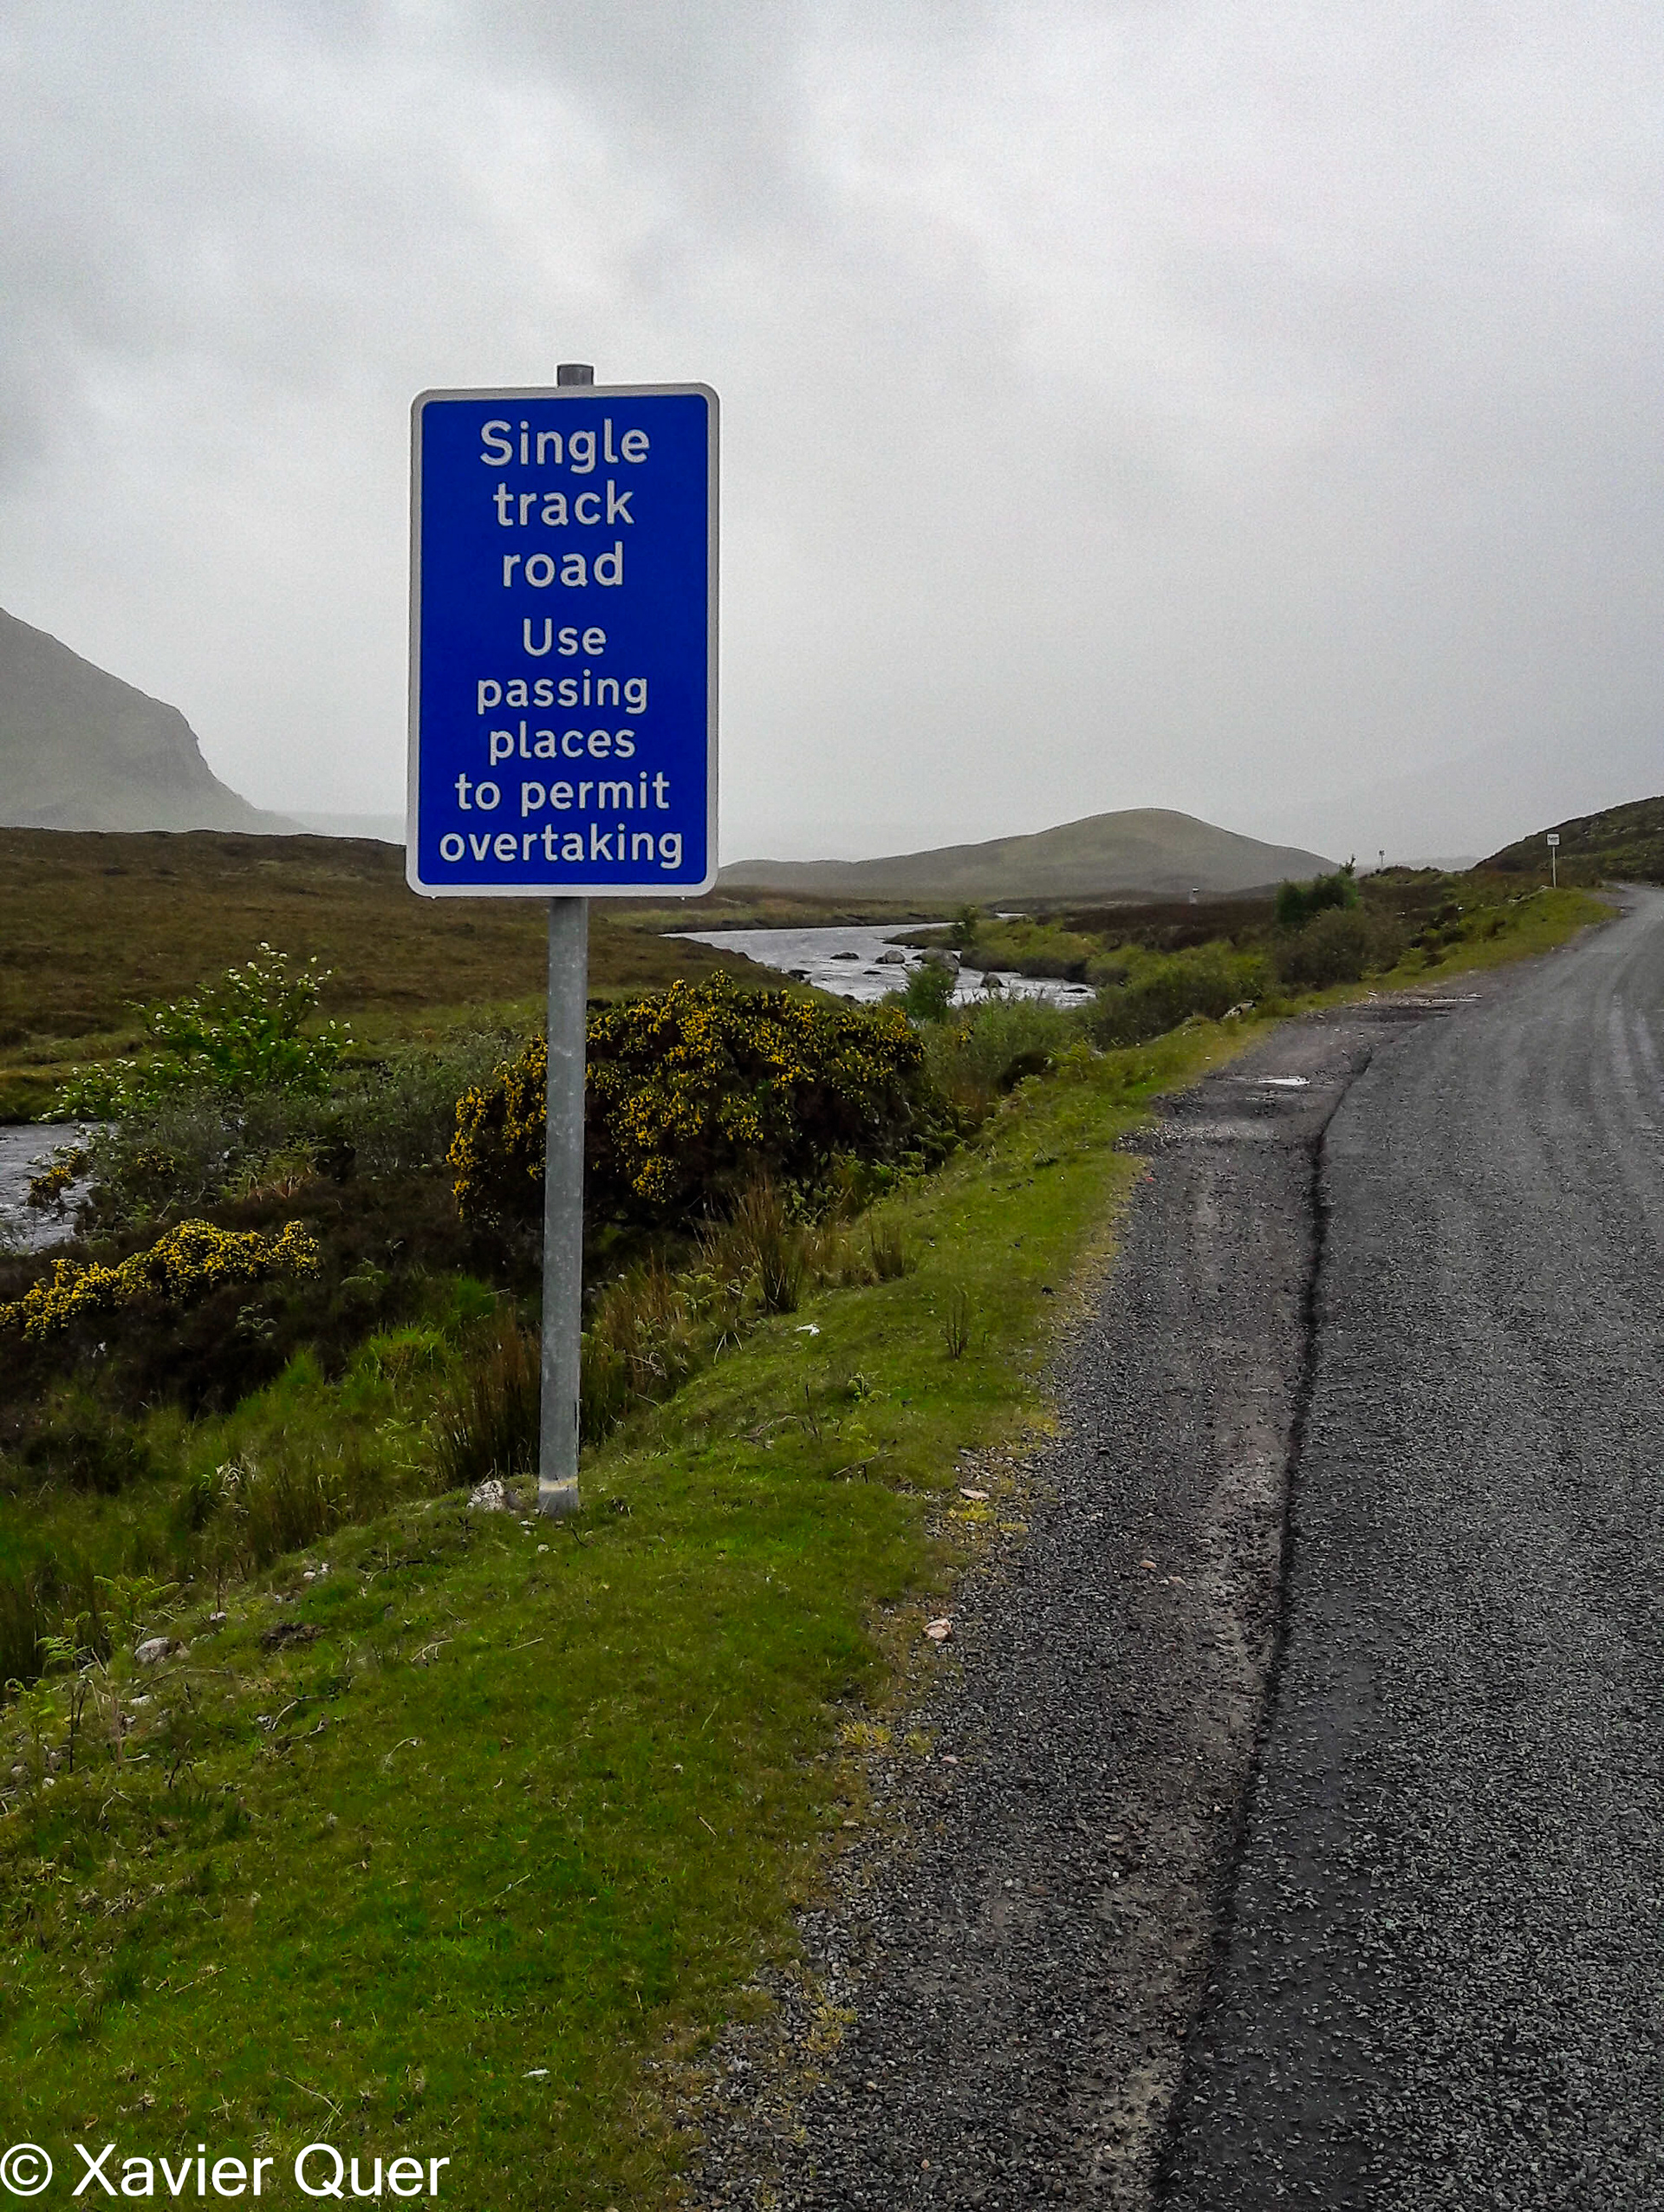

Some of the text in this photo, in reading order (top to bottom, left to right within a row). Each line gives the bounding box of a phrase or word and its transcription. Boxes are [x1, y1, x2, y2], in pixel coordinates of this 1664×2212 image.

[479, 418, 651, 474] Single
[492, 479, 634, 526] track
[503, 540, 624, 588] road
[522, 617, 607, 656] Use
[477, 668, 648, 715] passing
[489, 719, 636, 767] places
[454, 771, 671, 817] to permit
[439, 823, 683, 870] overtaking
